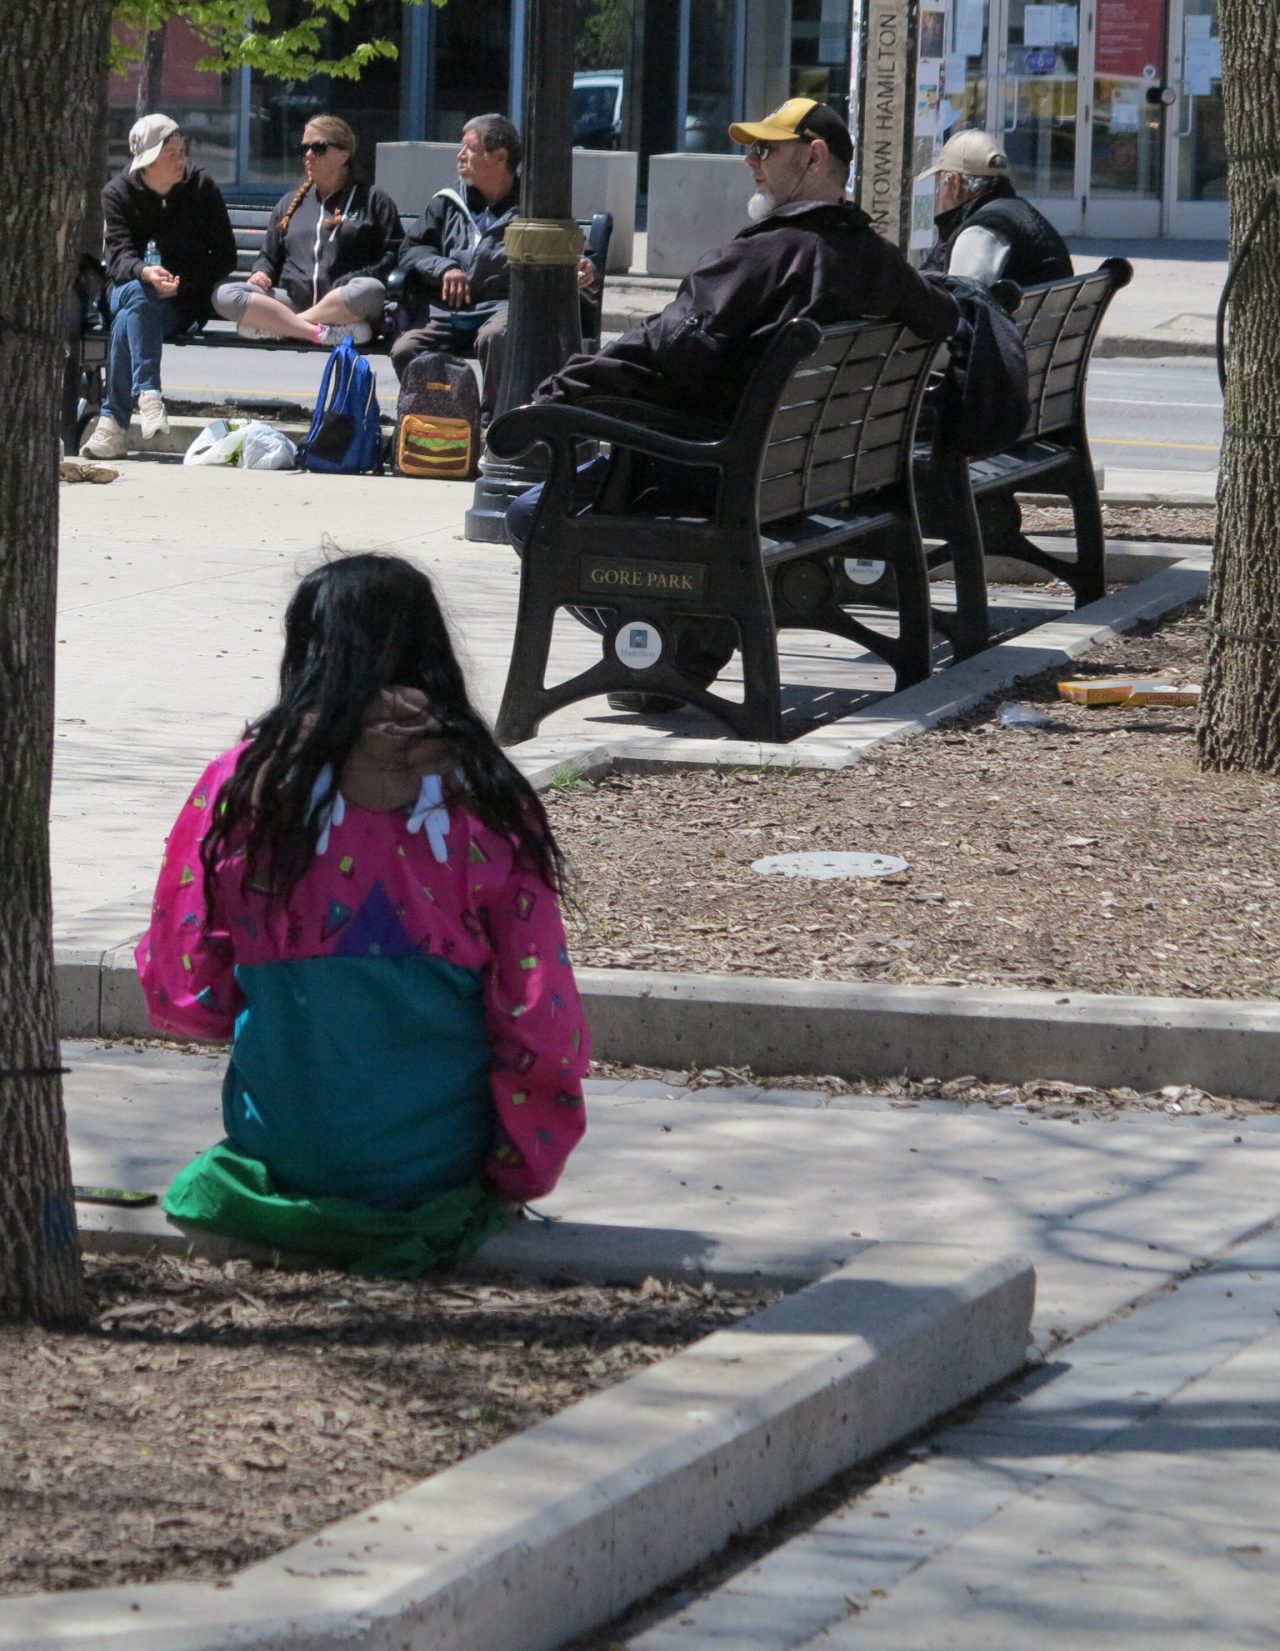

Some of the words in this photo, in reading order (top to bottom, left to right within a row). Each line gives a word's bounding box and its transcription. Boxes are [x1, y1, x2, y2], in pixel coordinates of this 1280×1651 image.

[876, 13, 897, 131] HAMILTON
[591, 568, 642, 586] GORE
[647, 573, 693, 590] PARK
